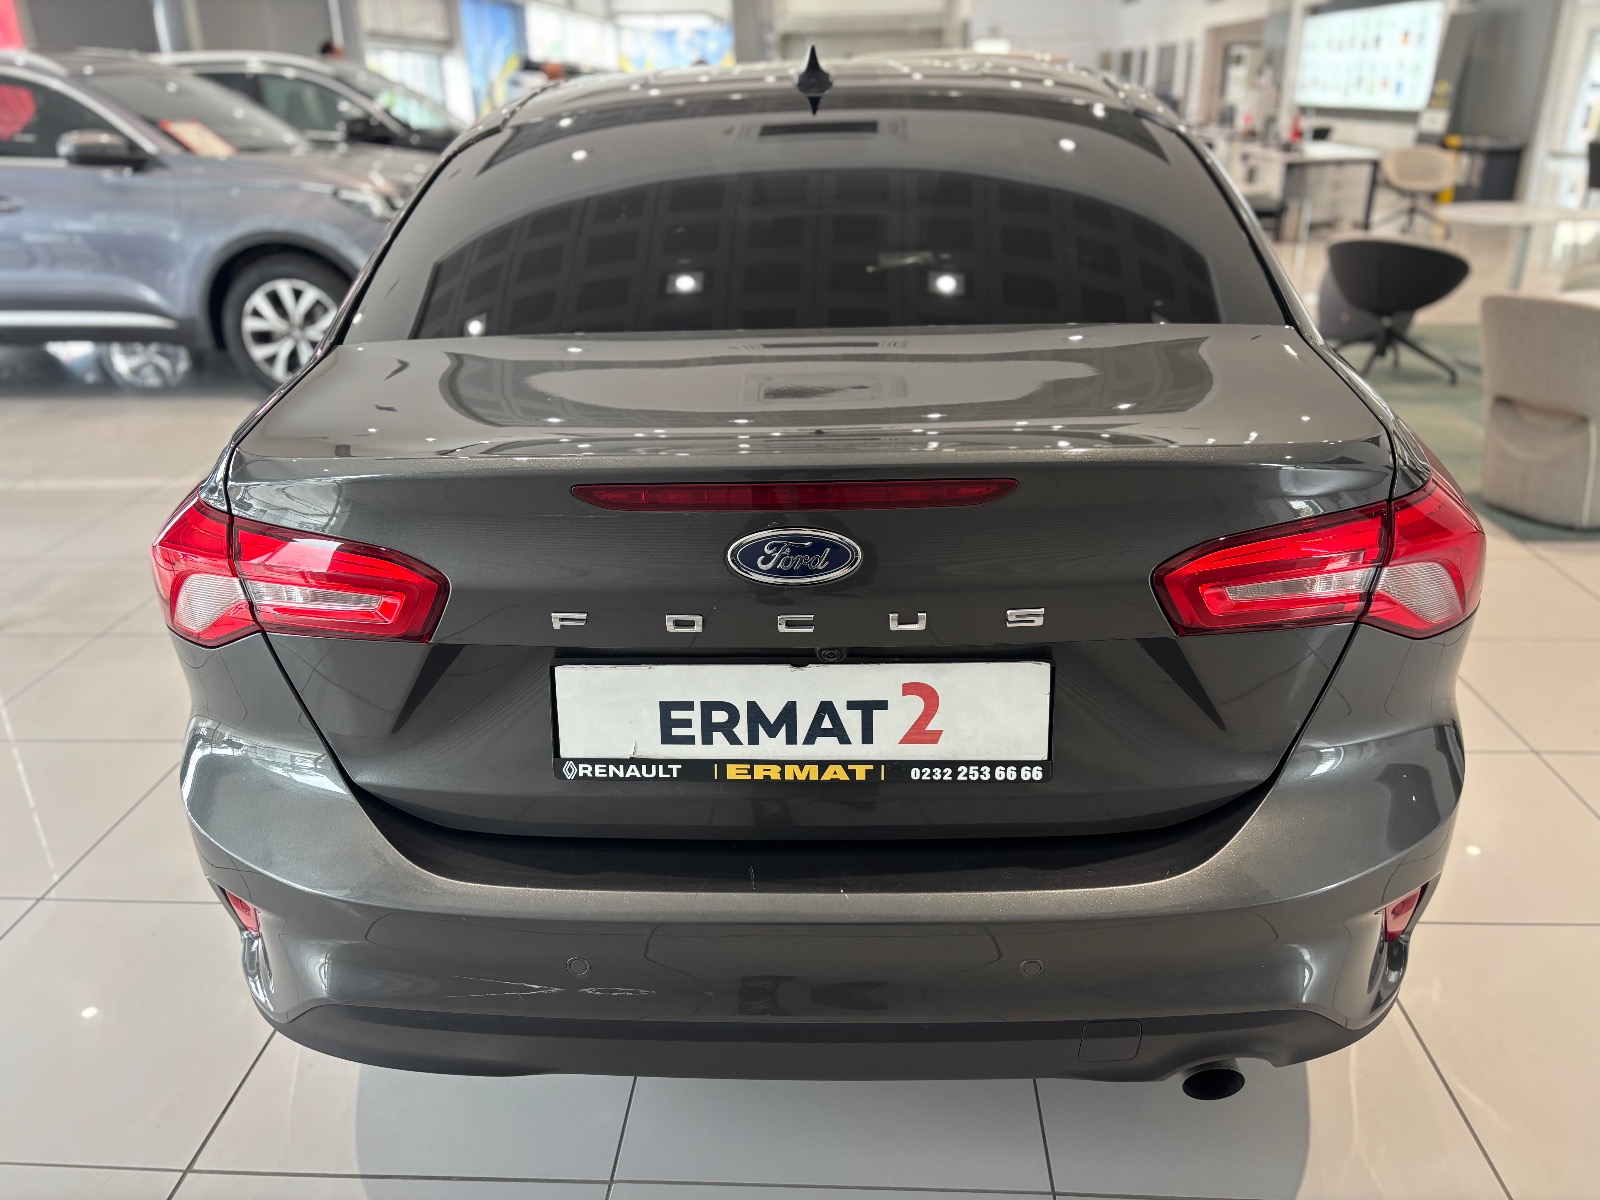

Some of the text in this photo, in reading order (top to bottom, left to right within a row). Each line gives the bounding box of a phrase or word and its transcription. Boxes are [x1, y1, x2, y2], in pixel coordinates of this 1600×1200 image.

[757, 540, 831, 571] Ford
[551, 607, 1045, 633] FOCUS
[659, 681, 944, 746] ERMAT 2
[578, 764, 1043, 781] RENAULT ERMAT 0232 253 66 66
